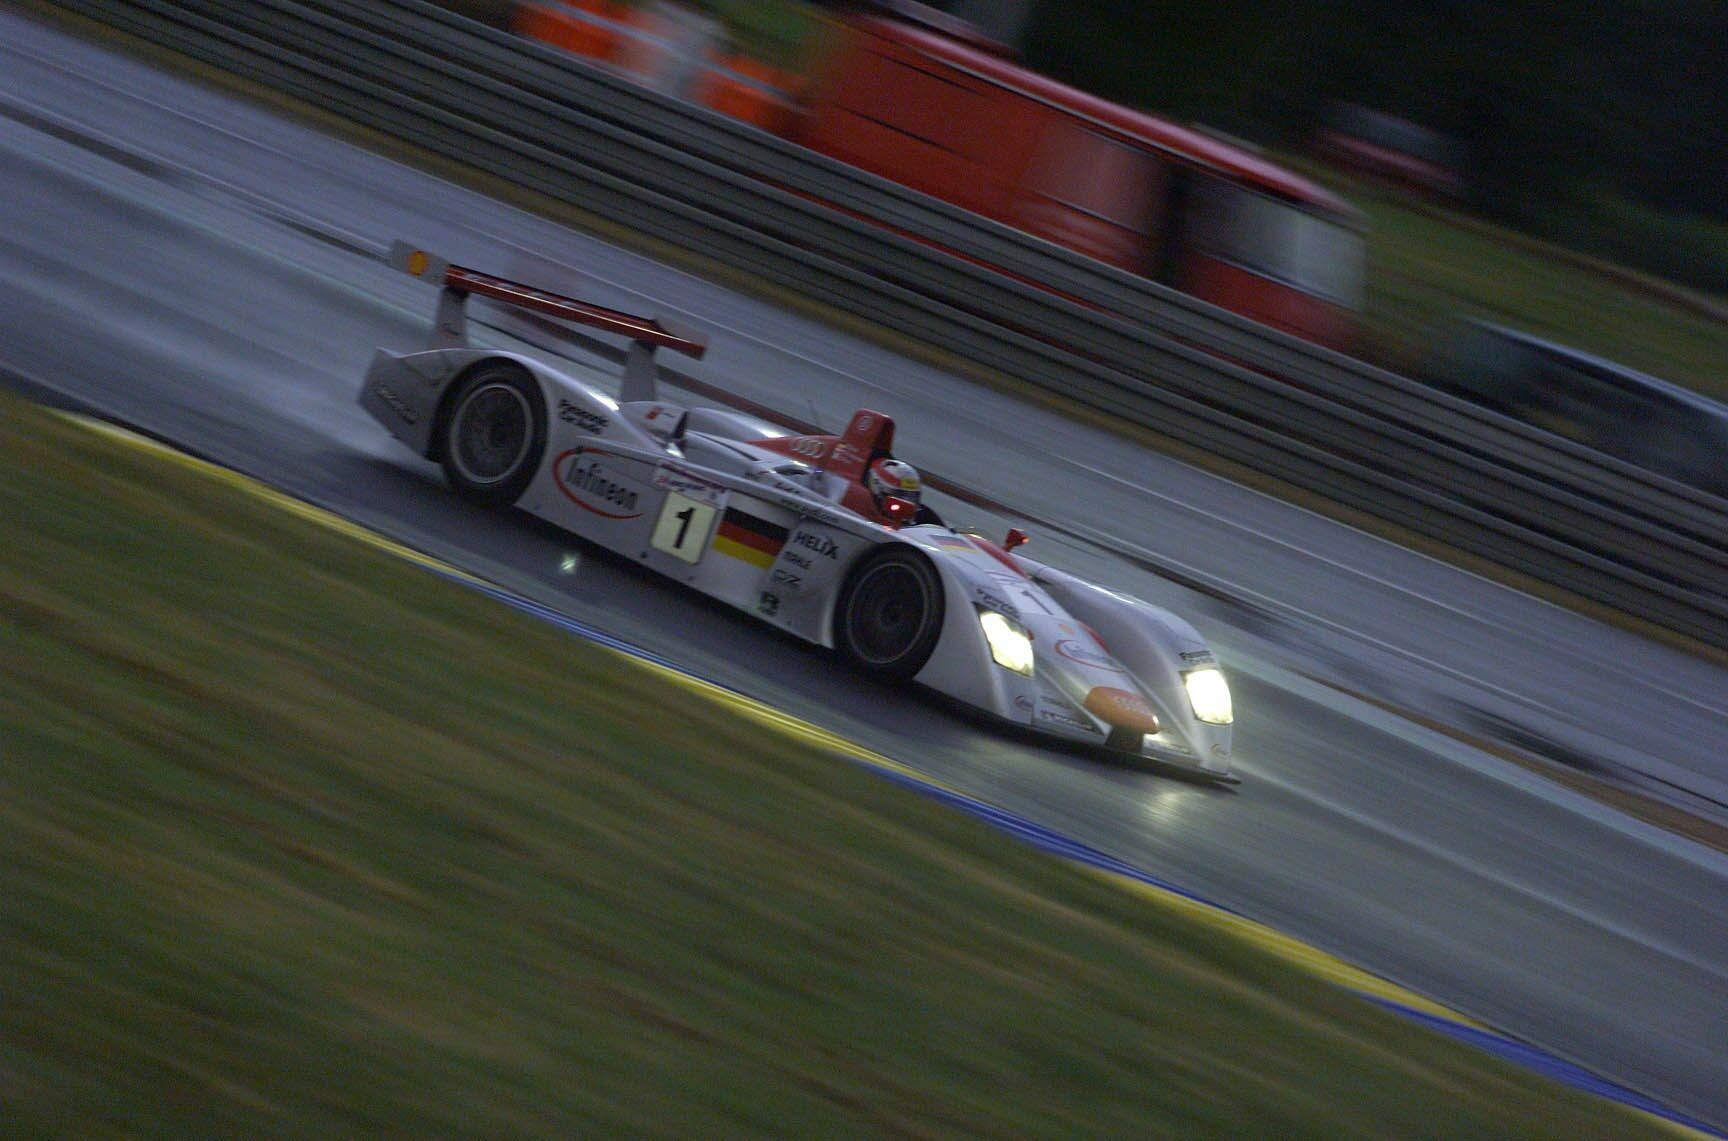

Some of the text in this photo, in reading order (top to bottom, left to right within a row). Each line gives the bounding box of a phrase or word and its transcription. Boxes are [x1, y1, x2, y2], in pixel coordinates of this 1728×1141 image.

[566, 457, 638, 510] Infineon
[674, 507, 696, 549] 1
[794, 530, 839, 559] HELIX
